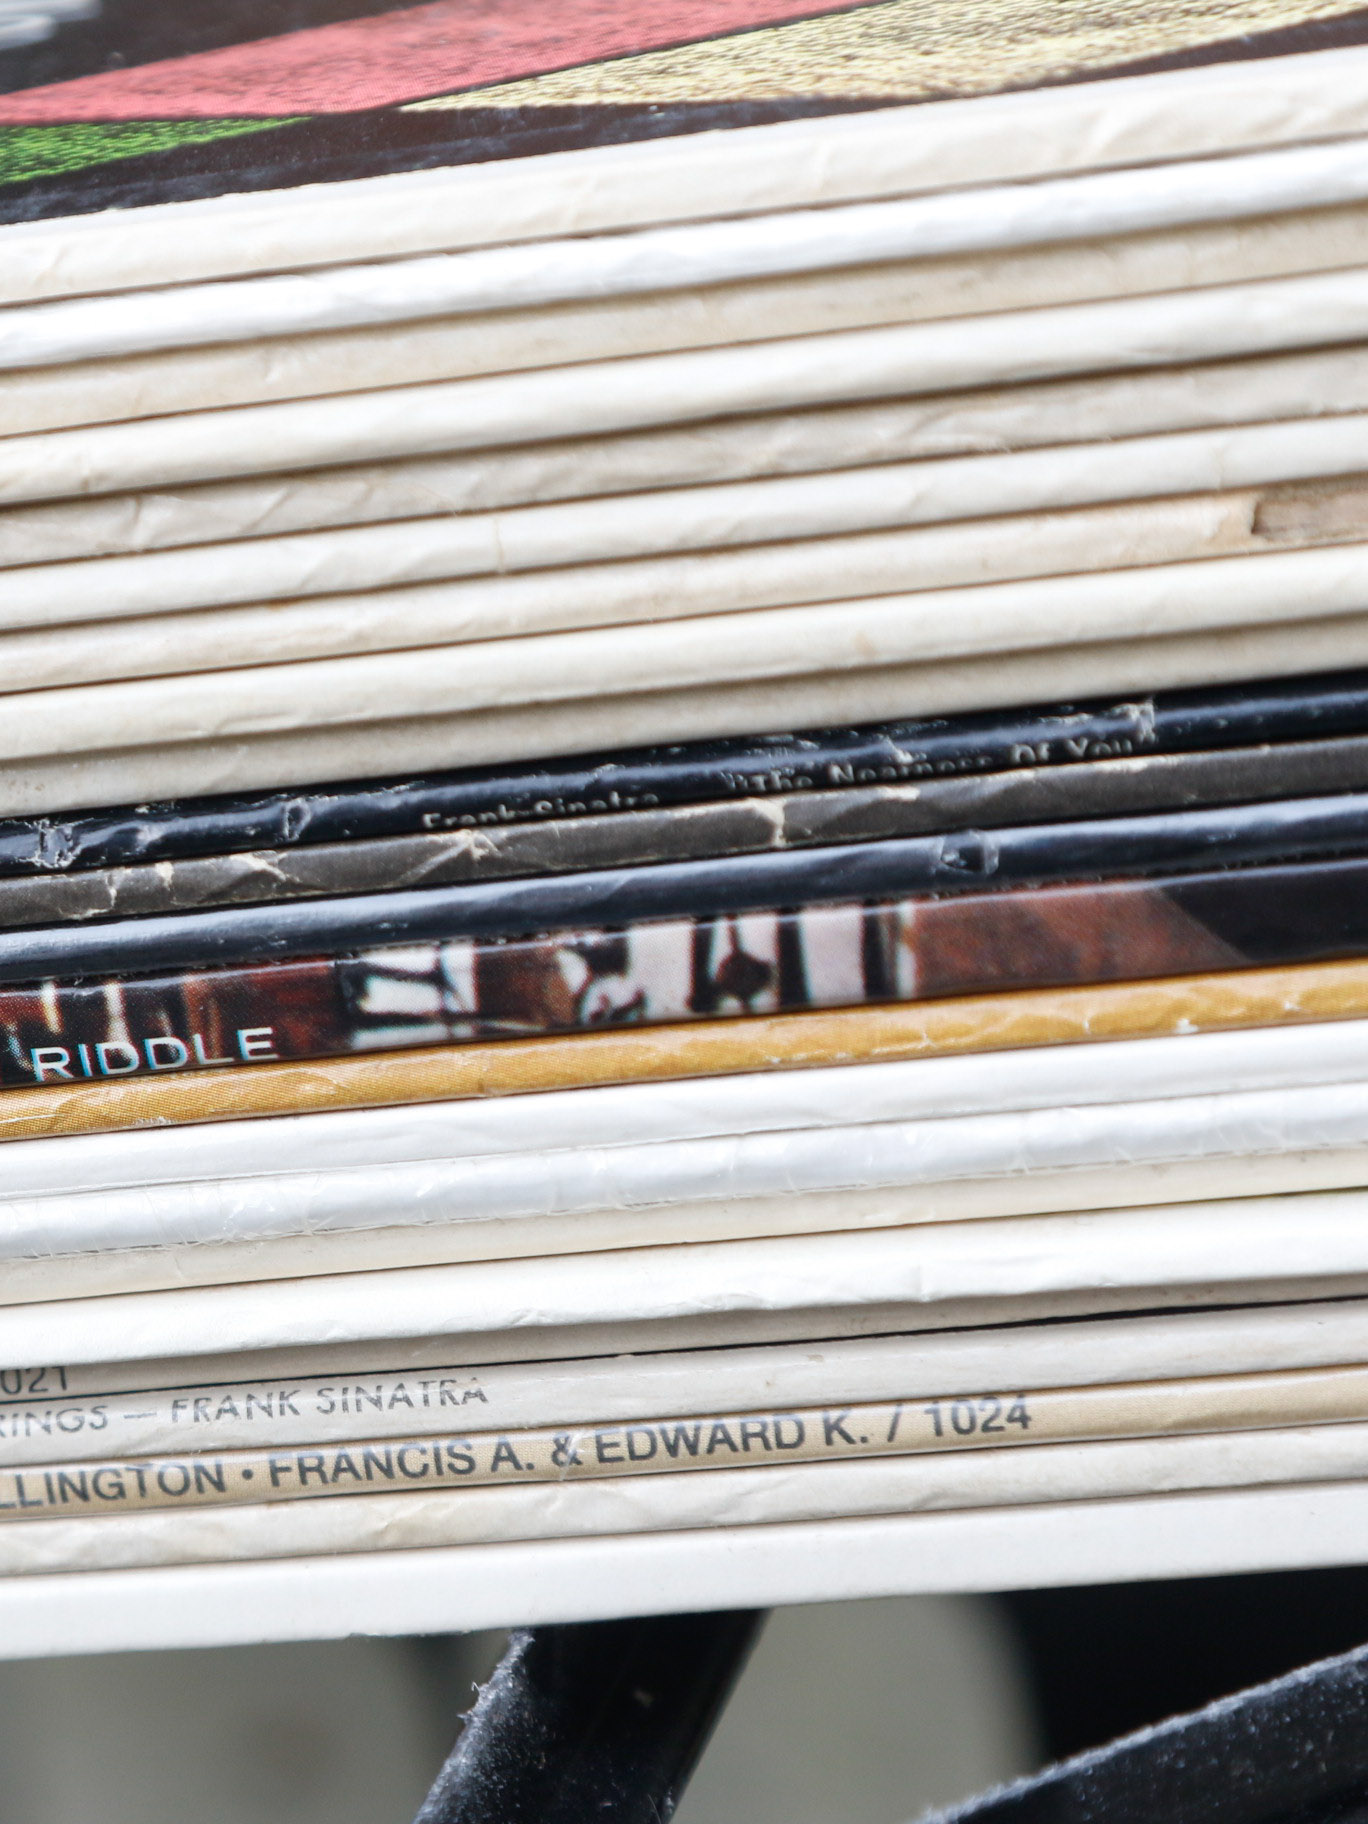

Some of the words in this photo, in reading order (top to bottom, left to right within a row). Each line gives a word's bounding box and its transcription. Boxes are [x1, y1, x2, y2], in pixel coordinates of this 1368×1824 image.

[31, 1026, 280, 1083] RIDDLE
[170, 1389, 301, 1424] FRANK
[315, 1376, 490, 1415] SINATRA
[268, 1438, 478, 1489] FRANCIS
[489, 1436, 536, 1473] A.
[550, 1431, 584, 1468] &
[594, 1411, 807, 1465] EDWARD
[822, 1406, 870, 1447] K.
[925, 1393, 1033, 1438] 1024
